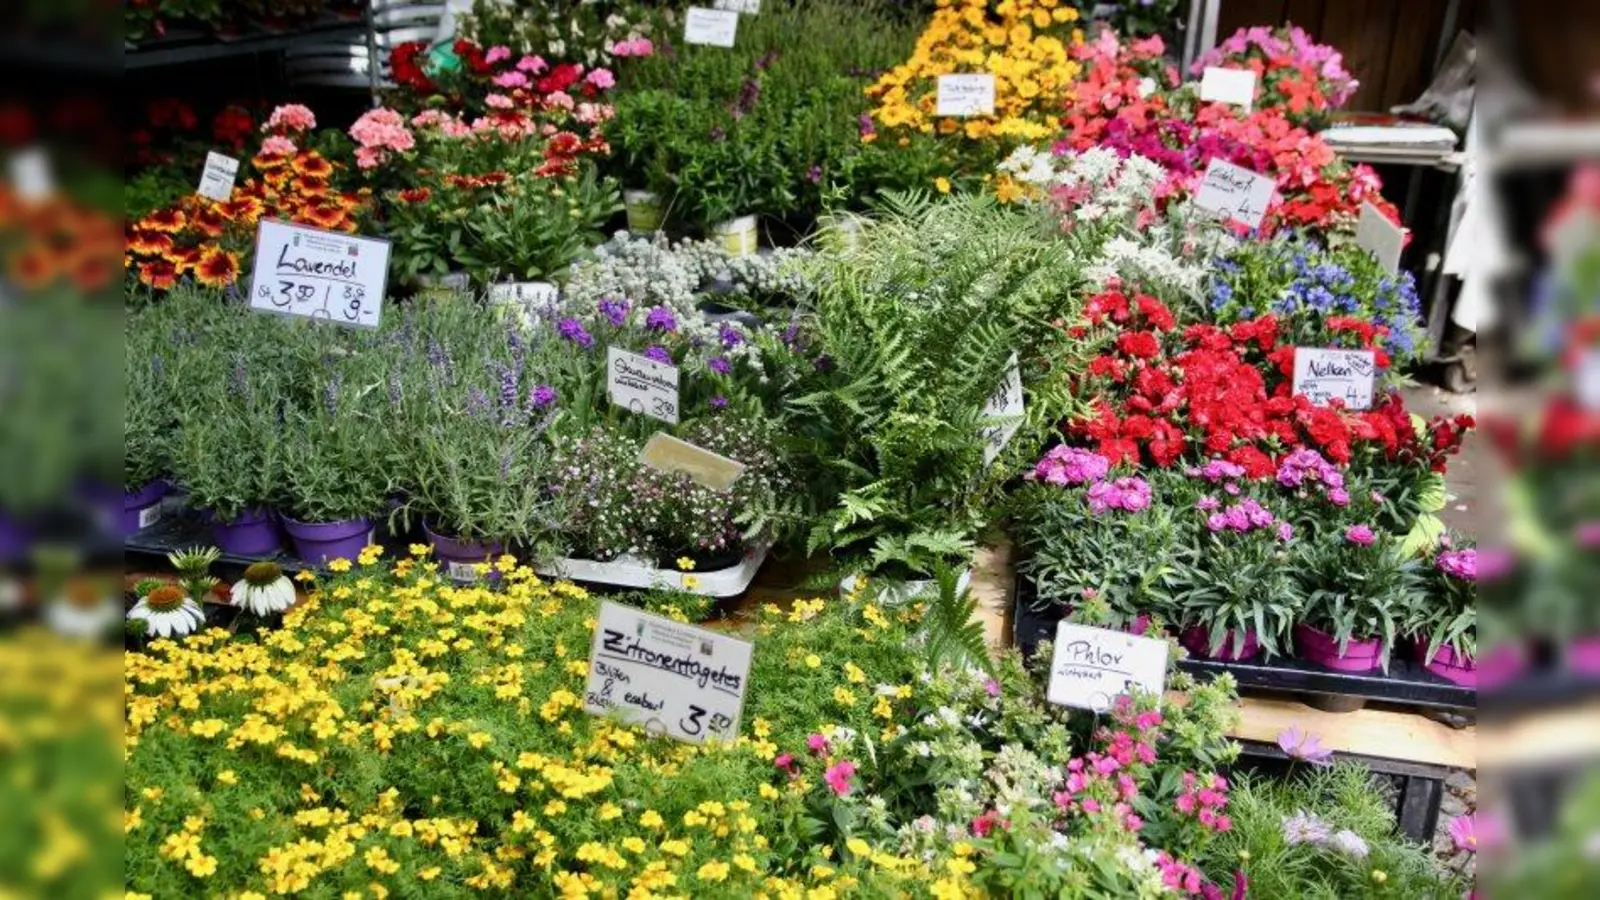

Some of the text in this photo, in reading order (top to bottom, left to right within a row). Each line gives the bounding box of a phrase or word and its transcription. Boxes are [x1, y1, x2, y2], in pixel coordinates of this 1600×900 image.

[277, 243, 357, 278] Lavendel
[1307, 359, 1353, 377] Nelken
[603, 629, 741, 689] Zitronentagetes
